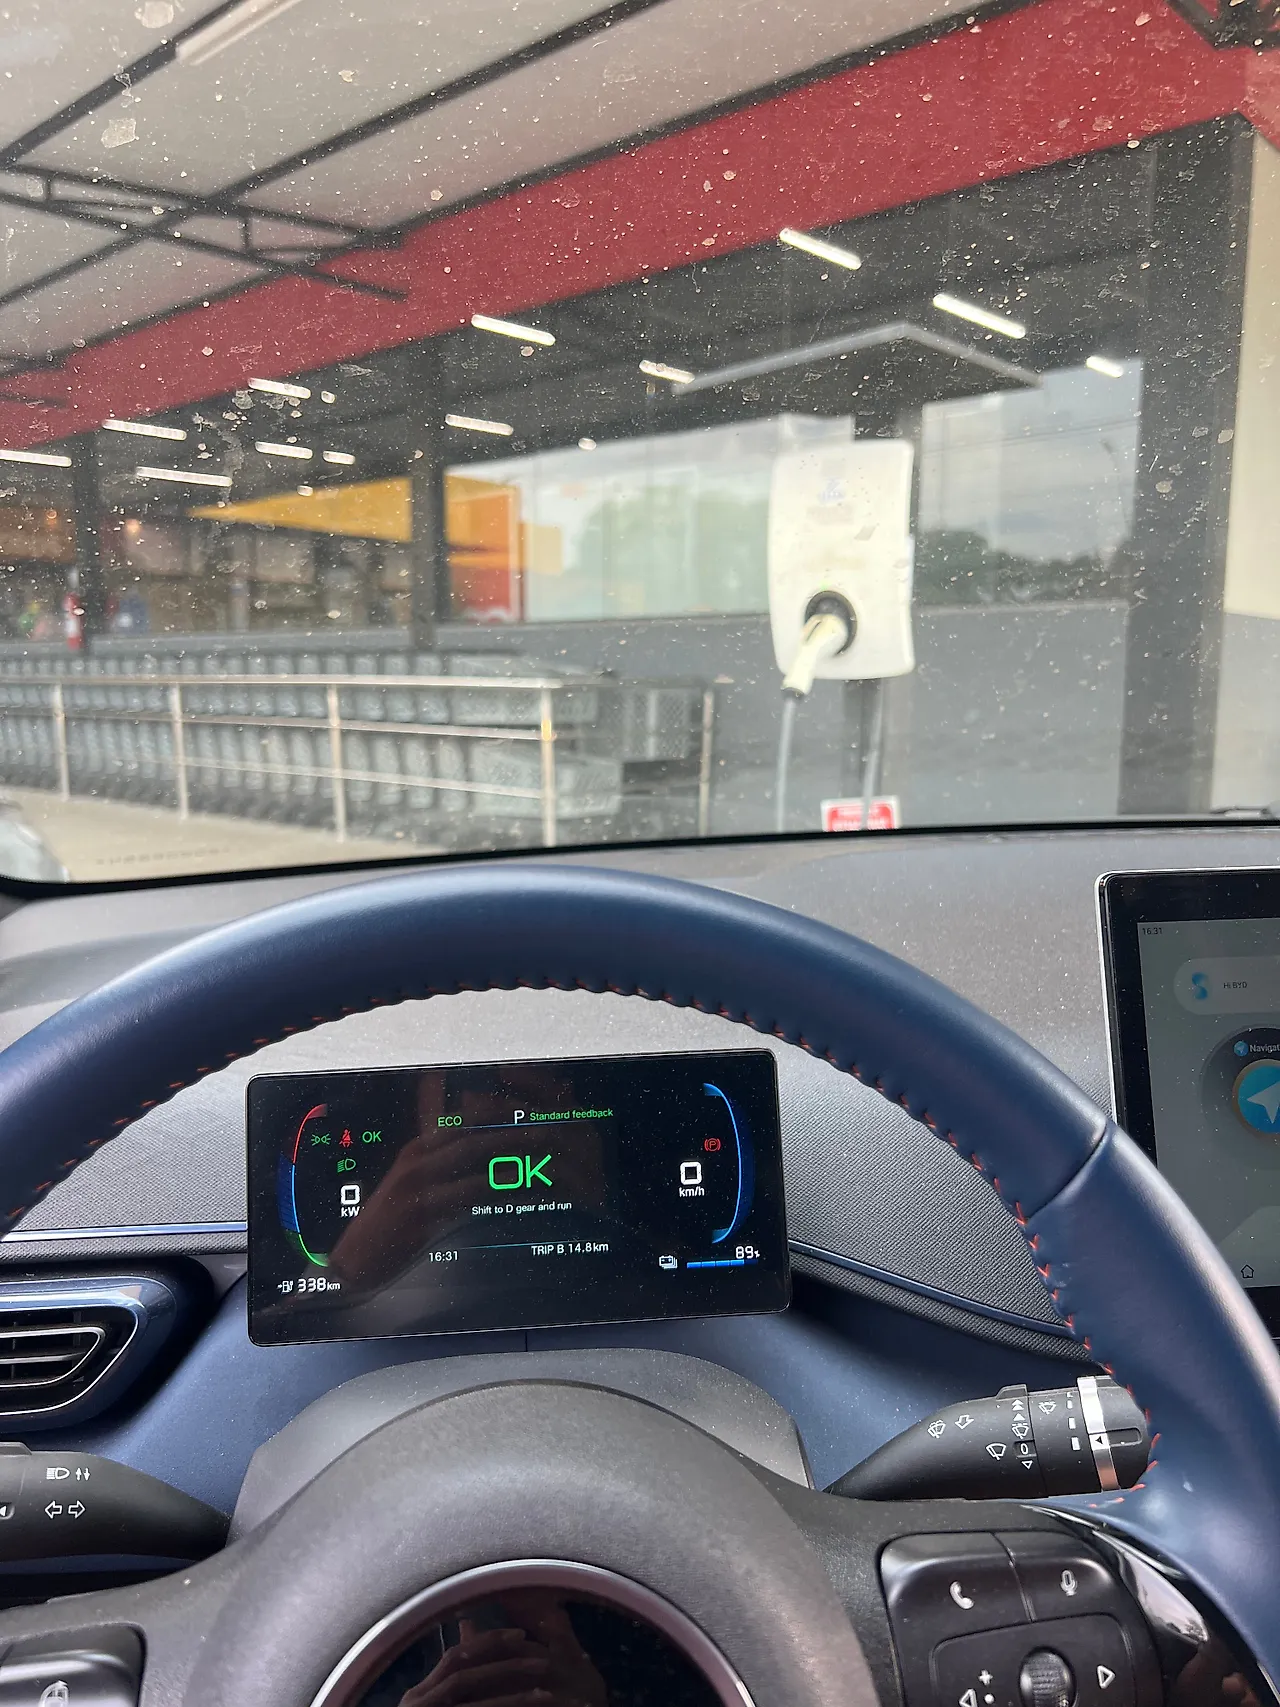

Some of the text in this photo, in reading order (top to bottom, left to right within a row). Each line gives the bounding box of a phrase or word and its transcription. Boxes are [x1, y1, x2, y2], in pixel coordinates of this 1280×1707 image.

[1142, 927, 1163, 935] 16:31
[514, 1110, 525, 1125] P
[529, 1108, 614, 1121] Standard feedback
[437, 1116, 463, 1127] ECO
[362, 1131, 382, 1143] OK
[488, 1154, 553, 1190] OK
[680, 1161, 703, 1186] 0
[340, 1184, 361, 1205] 0
[678, 1186, 705, 1198] km/h
[340, 1206, 361, 1218] kW
[471, 1201, 572, 1215] Shift to D gear and run
[531, 1244, 555, 1256] TRIP
[556, 1244, 565, 1254] B
[428, 1251, 459, 1263] 16:31
